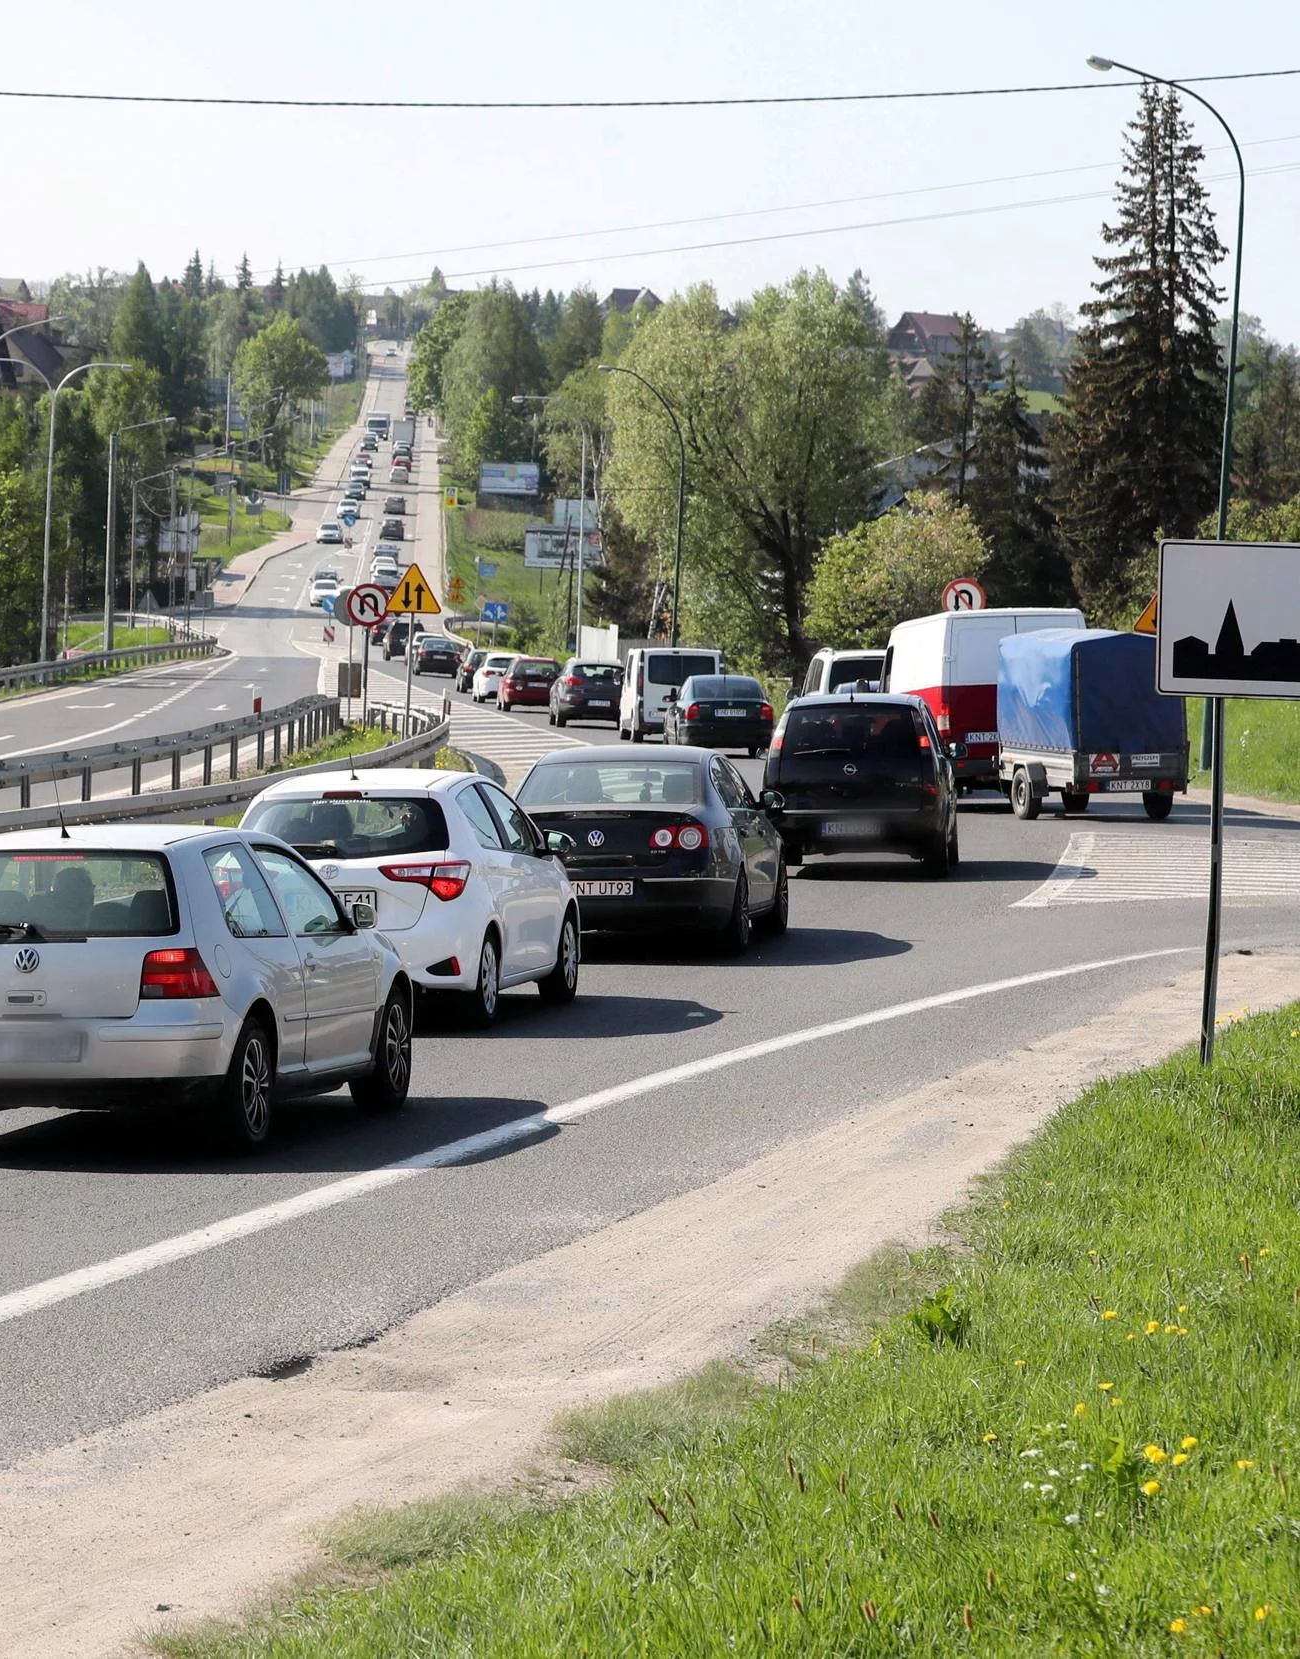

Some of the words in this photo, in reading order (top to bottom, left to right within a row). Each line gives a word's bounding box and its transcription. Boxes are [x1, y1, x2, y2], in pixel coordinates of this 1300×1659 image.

[970, 733, 985, 742] KNT
[1111, 781, 1127, 790] KNT
[571, 882, 594, 895] NT
[599, 882, 632, 895] UT93
